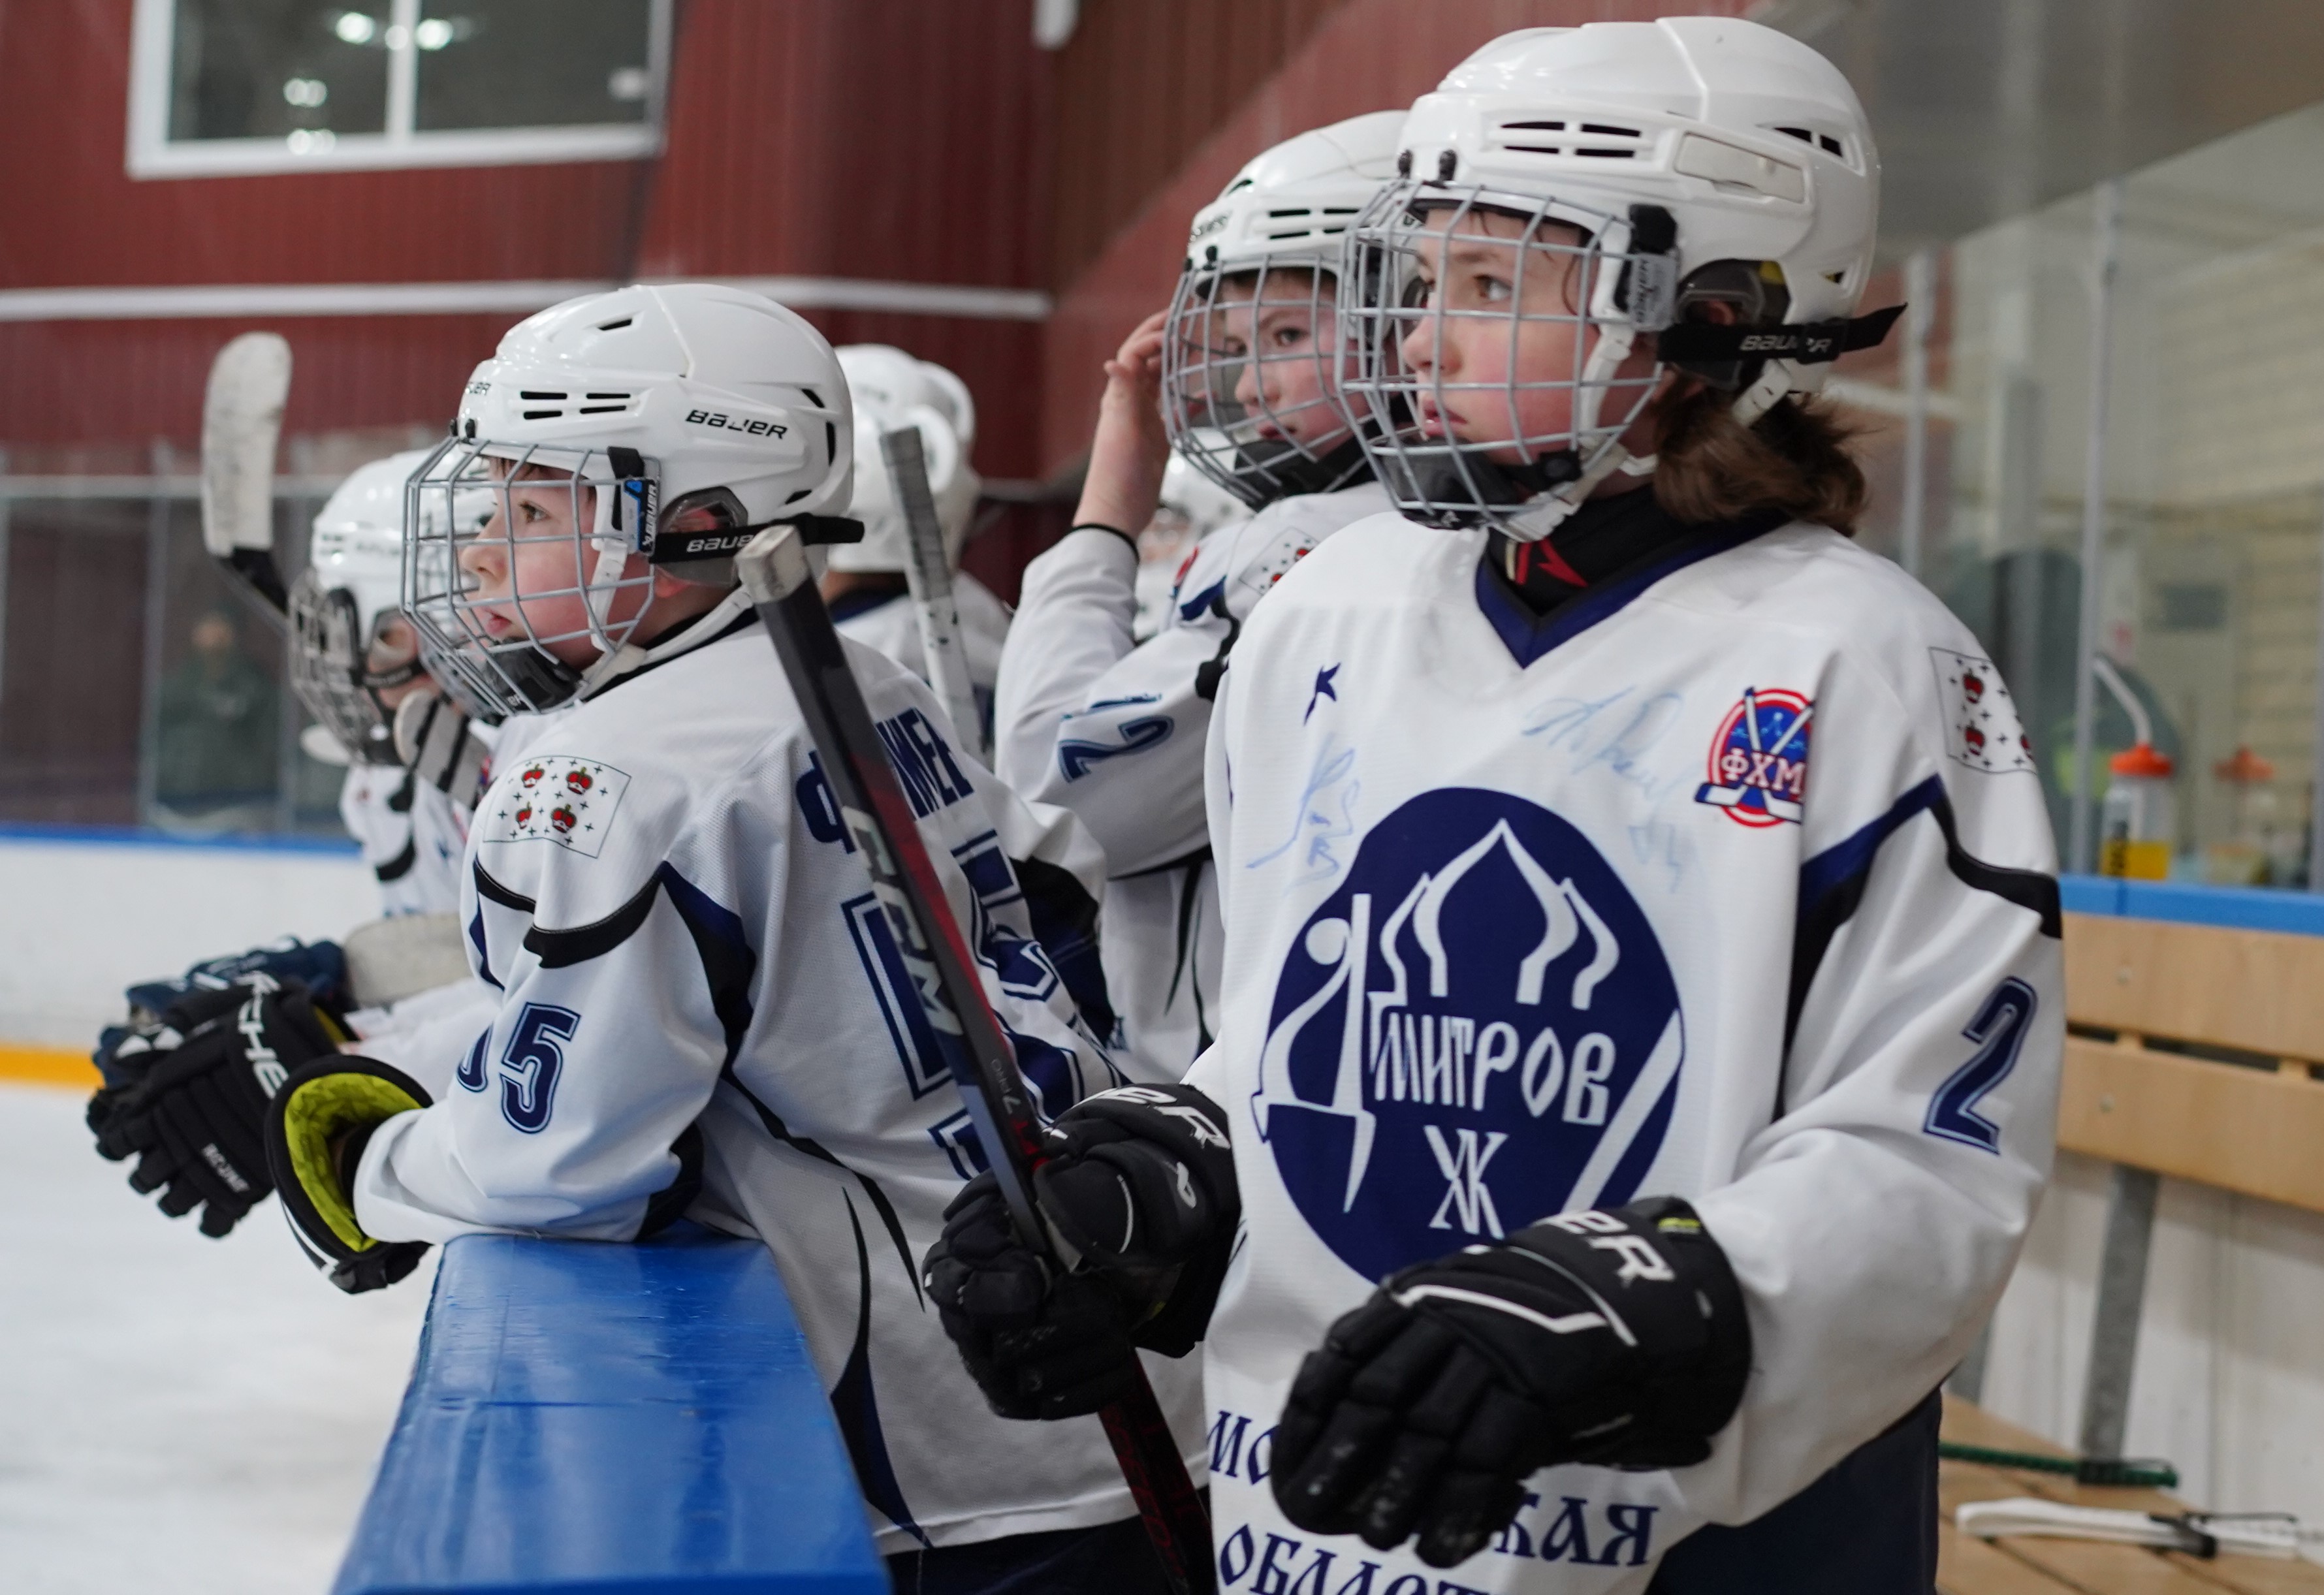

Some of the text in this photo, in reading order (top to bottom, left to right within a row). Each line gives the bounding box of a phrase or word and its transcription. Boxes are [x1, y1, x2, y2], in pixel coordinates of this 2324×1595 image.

[1739, 334, 1833, 354] BAUR
[685, 409, 788, 439] BAUER
[686, 534, 756, 553] BAUE
[1057, 693, 1175, 784] 2
[1721, 748, 1806, 795] ФХМ
[840, 805, 964, 1036] CCM
[1922, 975, 2039, 1156] 2
